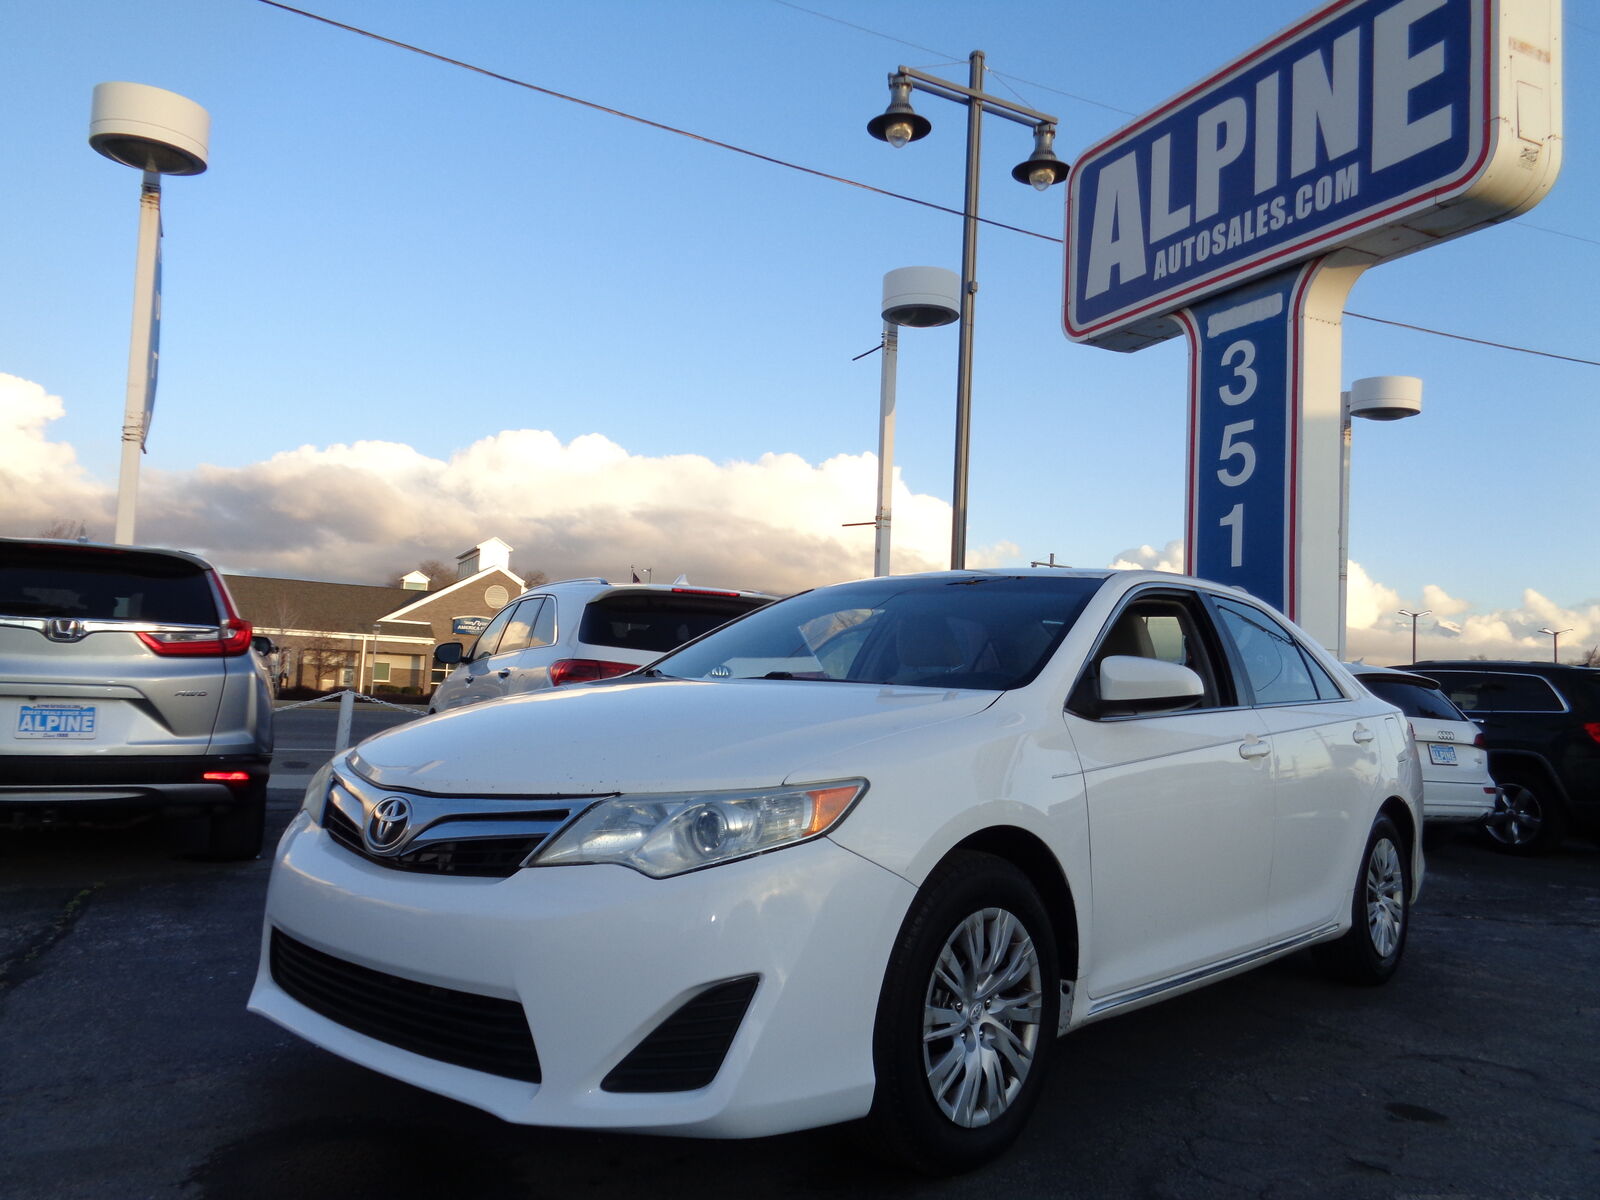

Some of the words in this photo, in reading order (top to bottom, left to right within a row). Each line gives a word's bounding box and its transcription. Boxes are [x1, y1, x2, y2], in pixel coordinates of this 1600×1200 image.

[1085, 0, 1453, 300] ALPINE
[1153, 162, 1359, 281] AUTOSALES.COM
[20, 715, 93, 732] ALPINE
